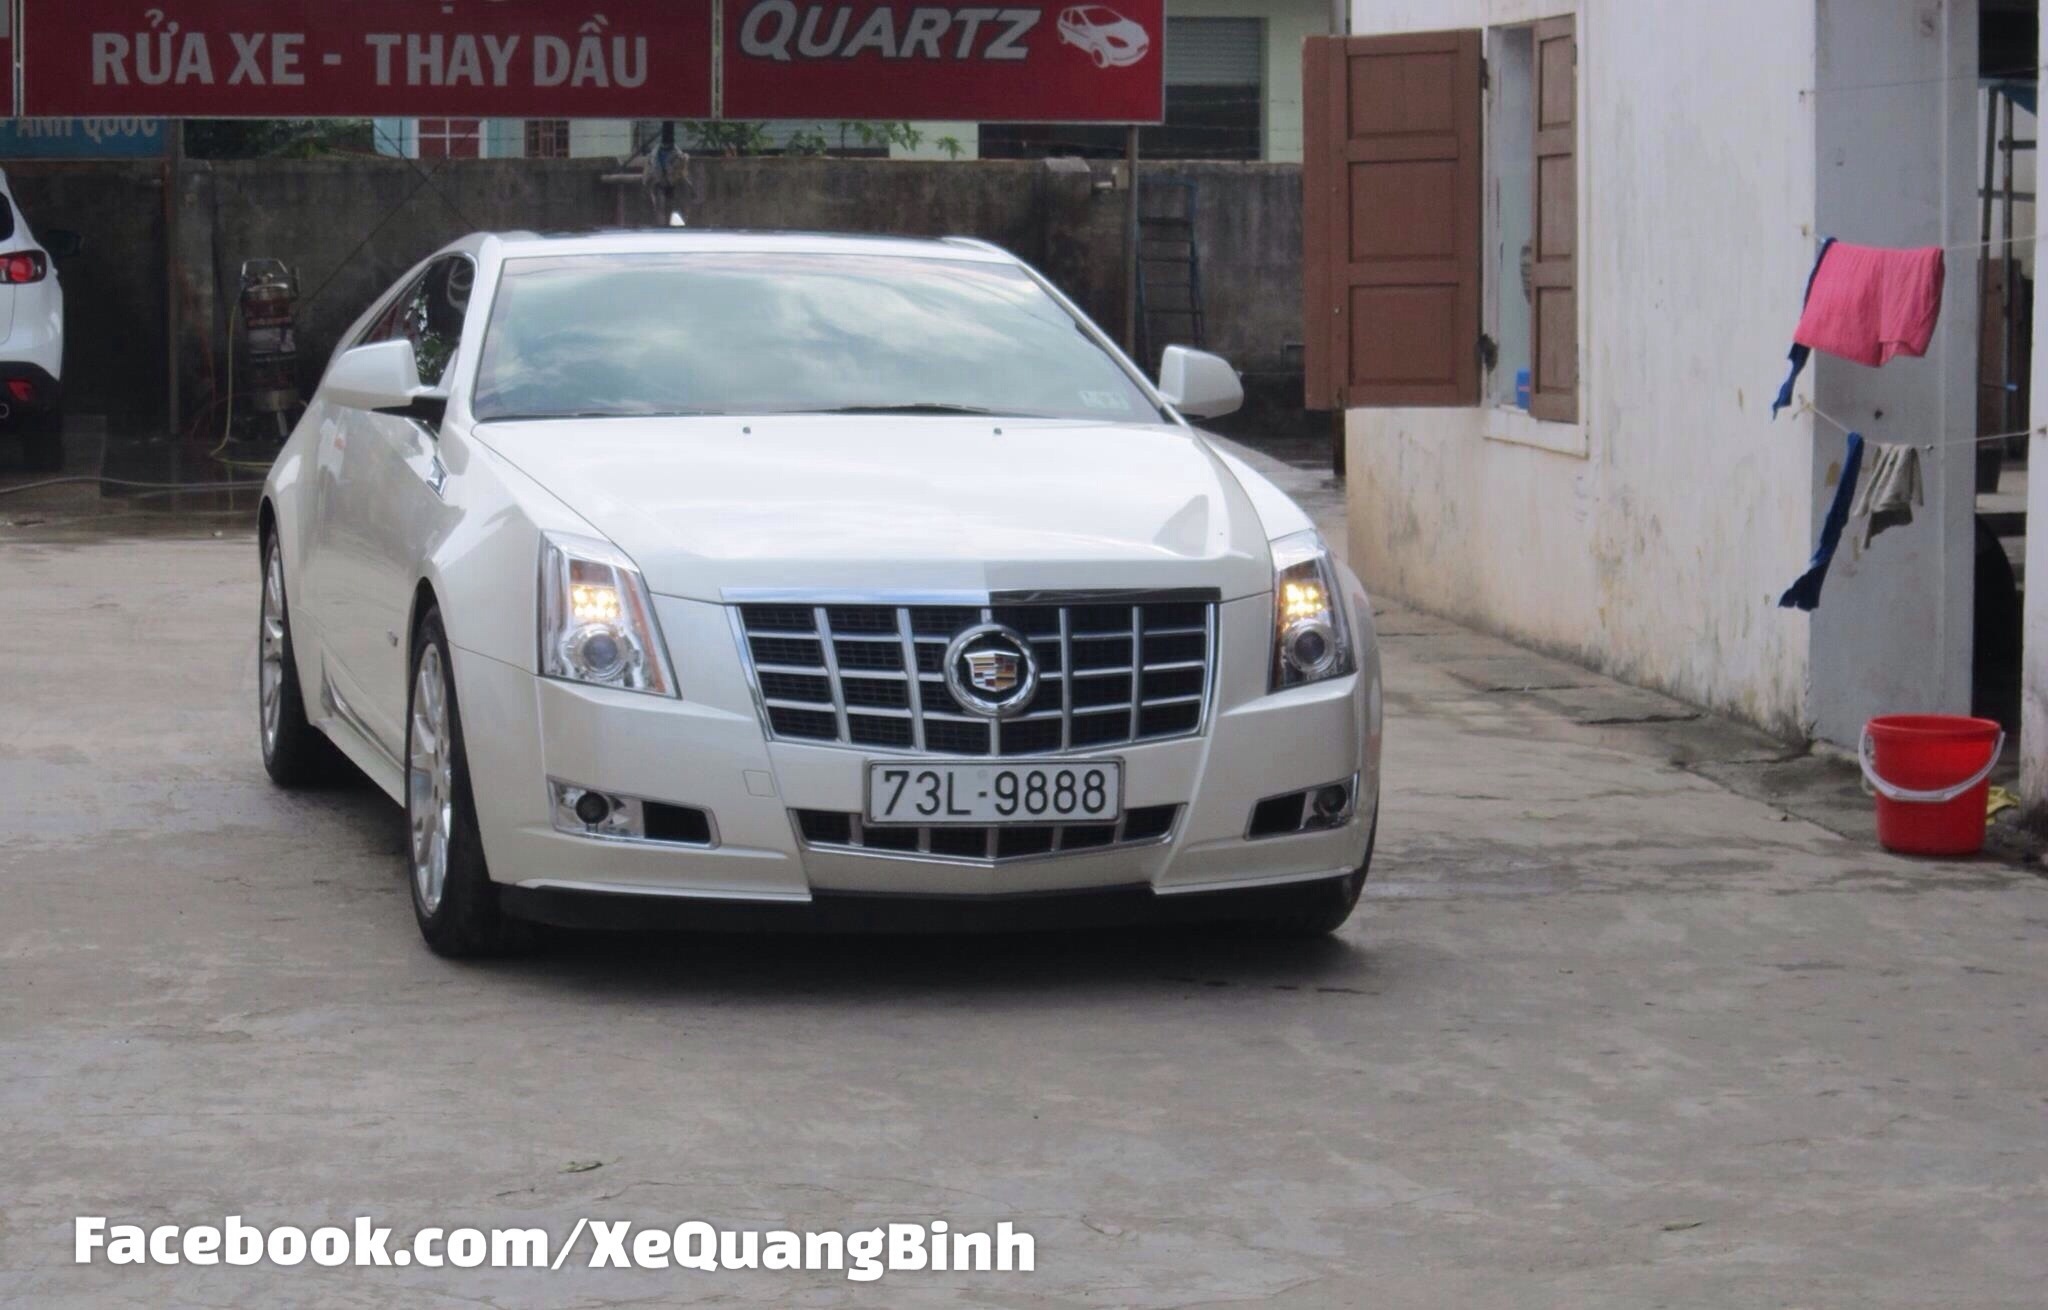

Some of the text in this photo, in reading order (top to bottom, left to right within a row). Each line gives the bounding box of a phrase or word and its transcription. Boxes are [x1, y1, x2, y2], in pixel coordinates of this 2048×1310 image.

[92, 9, 214, 85] RỬA
[228, 33, 305, 85] XE
[365, 33, 520, 86] THAY
[533, 14, 647, 88] DẦU
[740, 0, 1041, 61] QUARTZ
[884, 768, 1106, 816] 73L-9888
